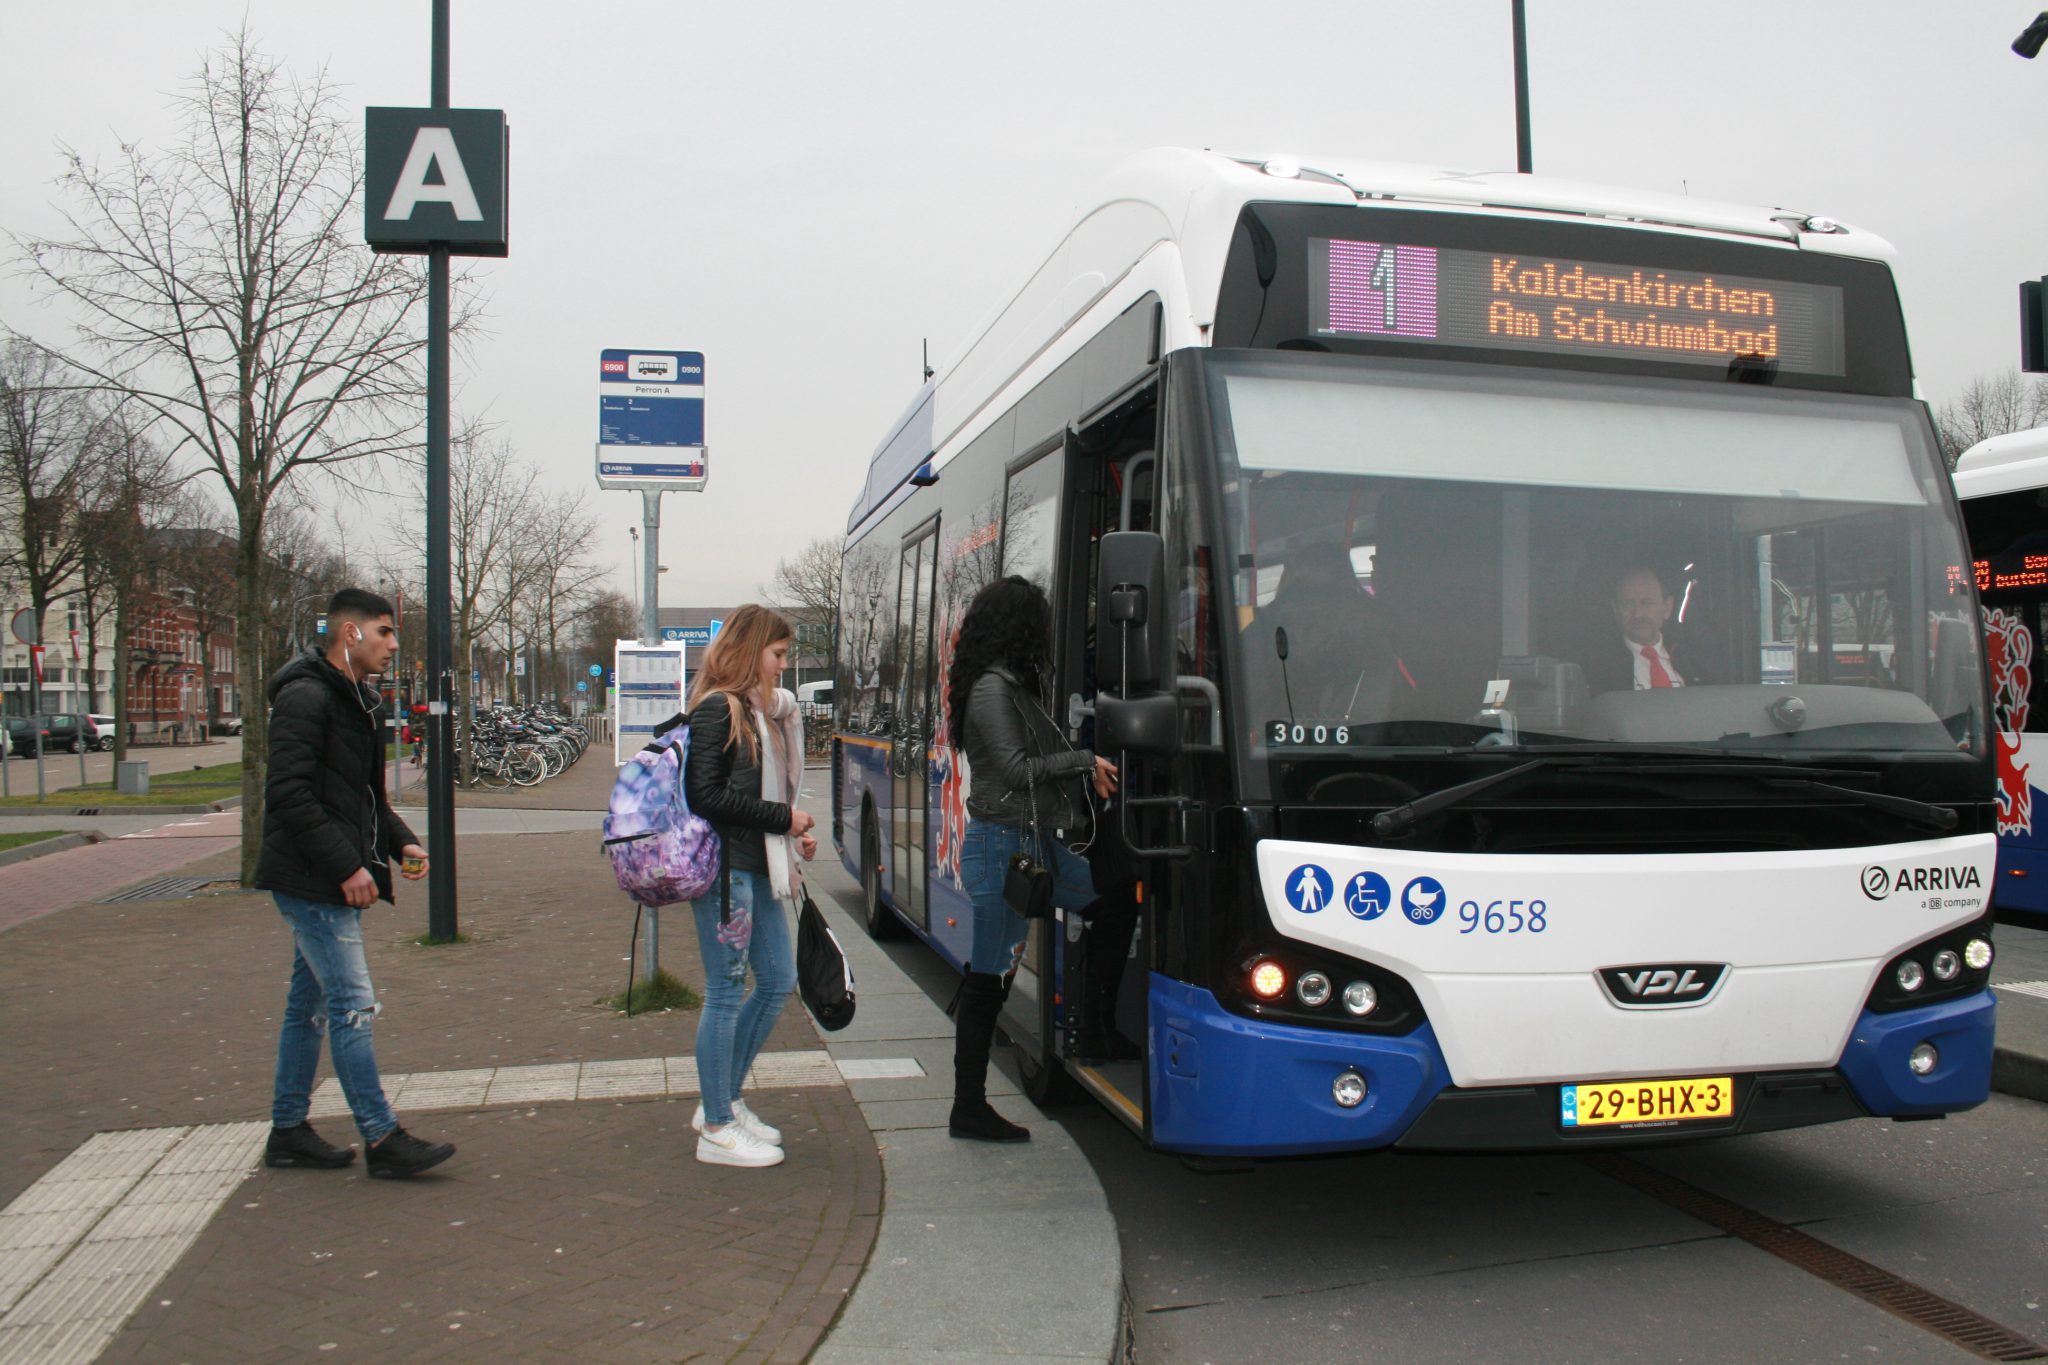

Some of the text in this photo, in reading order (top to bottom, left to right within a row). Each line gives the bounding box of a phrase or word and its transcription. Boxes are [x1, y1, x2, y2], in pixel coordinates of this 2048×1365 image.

[384, 127, 484, 221] A
[1373, 248, 1394, 325] 1
[1492, 258, 1774, 317] Kaldenkirchen
[1488, 301, 1777, 357] Am Schwimmbad
[604, 363, 624, 371] 6900
[681, 366, 700, 374] 0900
[635, 386, 662, 394] Perron
[678, 631, 709, 639] ARRIVA
[1274, 723, 1349, 744] 3006
[1894, 865, 1982, 892] ARRIVA
[1459, 899, 1547, 934] 9658
[1921, 898, 1981, 909] a DB company
[1617, 969, 1705, 997] VDL
[1563, 1110, 1577, 1120] NL
[1588, 1084, 1721, 1119] 29-BHX-3
